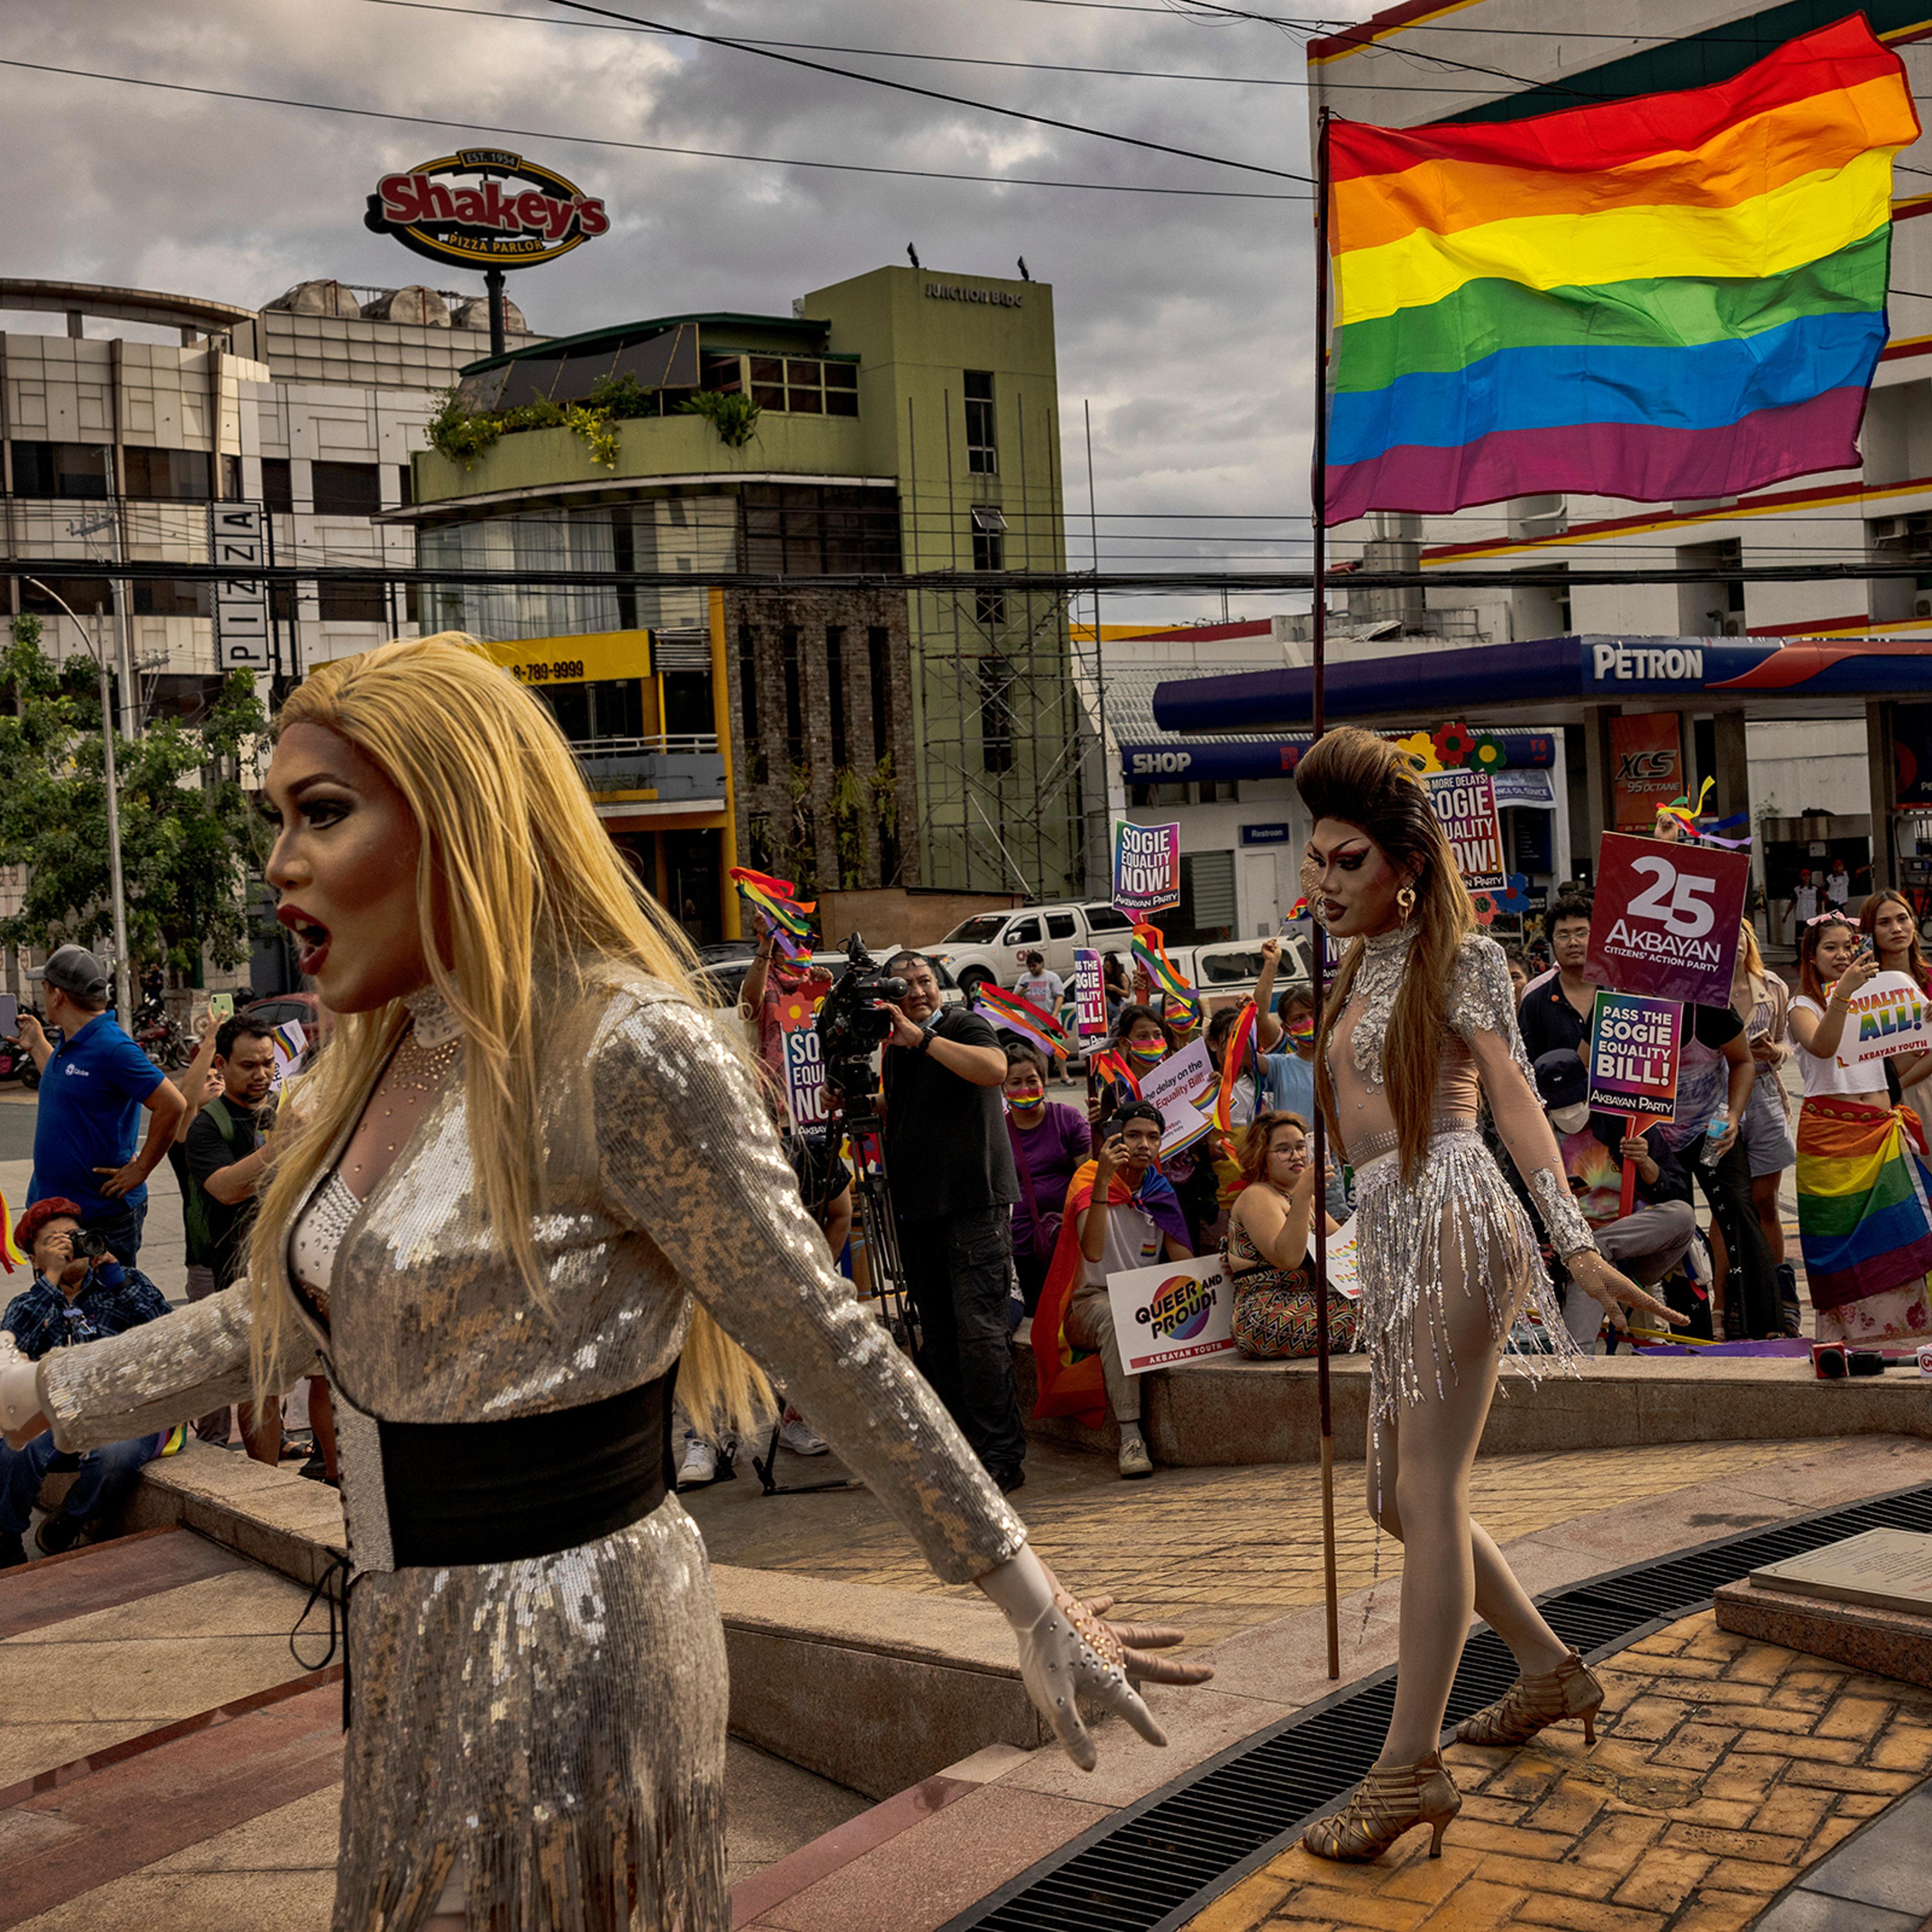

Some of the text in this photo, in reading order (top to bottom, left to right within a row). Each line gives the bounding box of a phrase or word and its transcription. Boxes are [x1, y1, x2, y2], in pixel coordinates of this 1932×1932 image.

[466, 152, 516, 166] EST. 1954
[379, 173, 610, 241] Shakey's
[449, 233, 544, 254] PIZZA PARLOR
[223, 512, 260, 660] PIZZA
[1592, 640, 1704, 680] PETRON
[1132, 752, 1192, 774] SHOP
[1615, 749, 1677, 780] XCS
[1432, 777, 1455, 789] MORE
[1456, 774, 1488, 787] DELAYS!
[1627, 781, 1680, 793] 95 OCTANE
[1122, 827, 1170, 854] SOGIE
[1251, 829, 1283, 839] Restroom
[1442, 818, 1493, 840] UALITY
[1121, 850, 1171, 868] EQUALITY
[1449, 839, 1498, 874] OW!
[1120, 864, 1170, 894] NOW!
[1474, 876, 1502, 888] PARTY
[1626, 855, 1717, 939] 25
[1605, 919, 1721, 963] AKBAYAN
[1083, 960, 1098, 971] THE
[1604, 945, 1719, 973] CITIZENS' ACTION PARTY
[1078, 1002, 1103, 1024] ILL!
[1848, 987, 1916, 1015] QUALITY
[1602, 1006, 1672, 1025] PASS THE
[1859, 1002, 1922, 1042] ALL!
[1599, 1019, 1672, 1046] SOGIE
[1598, 1040, 1671, 1061] EQUALITY
[1858, 1039, 1928, 1062] AKBAYAN YOUTH
[1156, 1076, 1176, 1095] delay
[1177, 1069, 1188, 1080] on
[1188, 1060, 1203, 1073] the
[1596, 1054, 1670, 1086] BILL!
[1155, 1072, 1205, 1109] Equality Bill!
[1590, 1089, 1673, 1113] AKBAYAN PARTY
[798, 1125, 828, 1135] AKBAY
[1135, 1274, 1223, 1325] QUEER AND
[1151, 1289, 1218, 1340] PROUD!
[1149, 1342, 1222, 1364] AKBAYAN YOUTH
